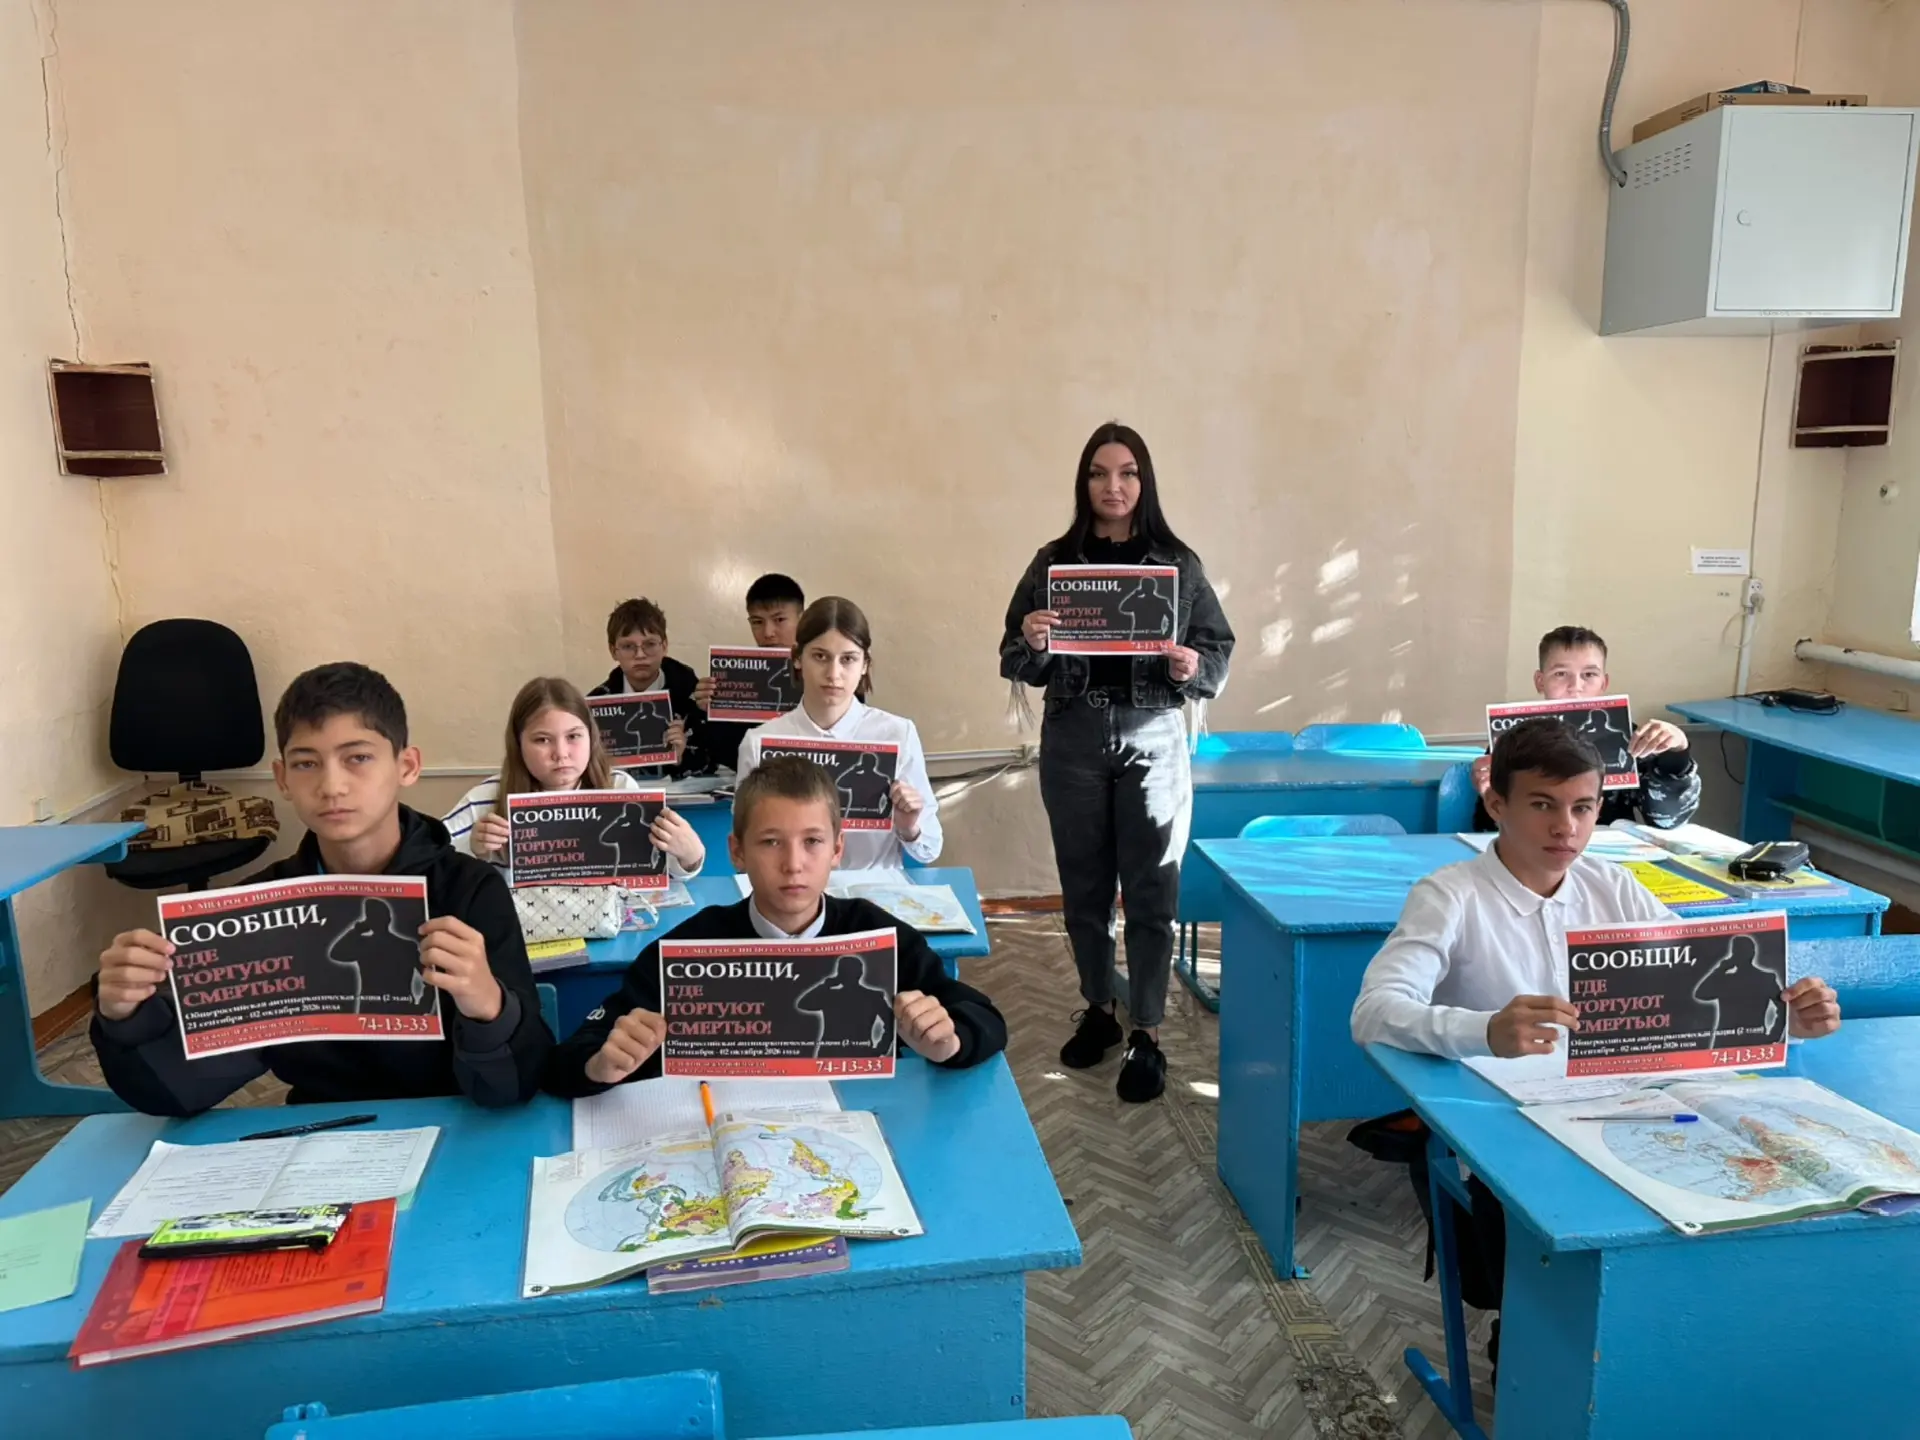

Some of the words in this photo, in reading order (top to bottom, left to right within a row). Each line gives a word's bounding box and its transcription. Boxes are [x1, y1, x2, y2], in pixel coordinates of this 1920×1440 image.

[1051, 579, 1122, 593] СООБЩИ,
[1060, 618, 1108, 628] МЕРТЬЮ!
[711, 658, 770, 672] СООБЩИ,
[717, 681, 754, 690] ОРГУЮТ
[512, 807, 602, 824] СООБЩИ,
[514, 827, 538, 840] ГДЕ
[514, 838, 580, 852] ТОРГУЮТ
[514, 852, 585, 866] СМЕРТЬЮ!
[170, 904, 328, 947] СООБЩИ,
[175, 948, 219, 969] ГДЕ
[1571, 946, 1697, 971] СООБЩИ,
[178, 955, 294, 988] ТОРГУЮТ
[666, 961, 800, 982] СООБЩИ,
[183, 975, 306, 1008] СМЕРТЬЮ!
[668, 984, 704, 999] ГДЕ
[1573, 979, 1607, 997] ГДЕ
[667, 1001, 765, 1018] ТОРГУЮТ
[1574, 994, 1665, 1015] ТОРГУЮТ
[358, 1016, 428, 1032] 74-13-33
[667, 1020, 772, 1035] СМЕРТЬЮ!
[1711, 1047, 1775, 1064] 74-13-33
[815, 1060, 883, 1074] 74-13-33
